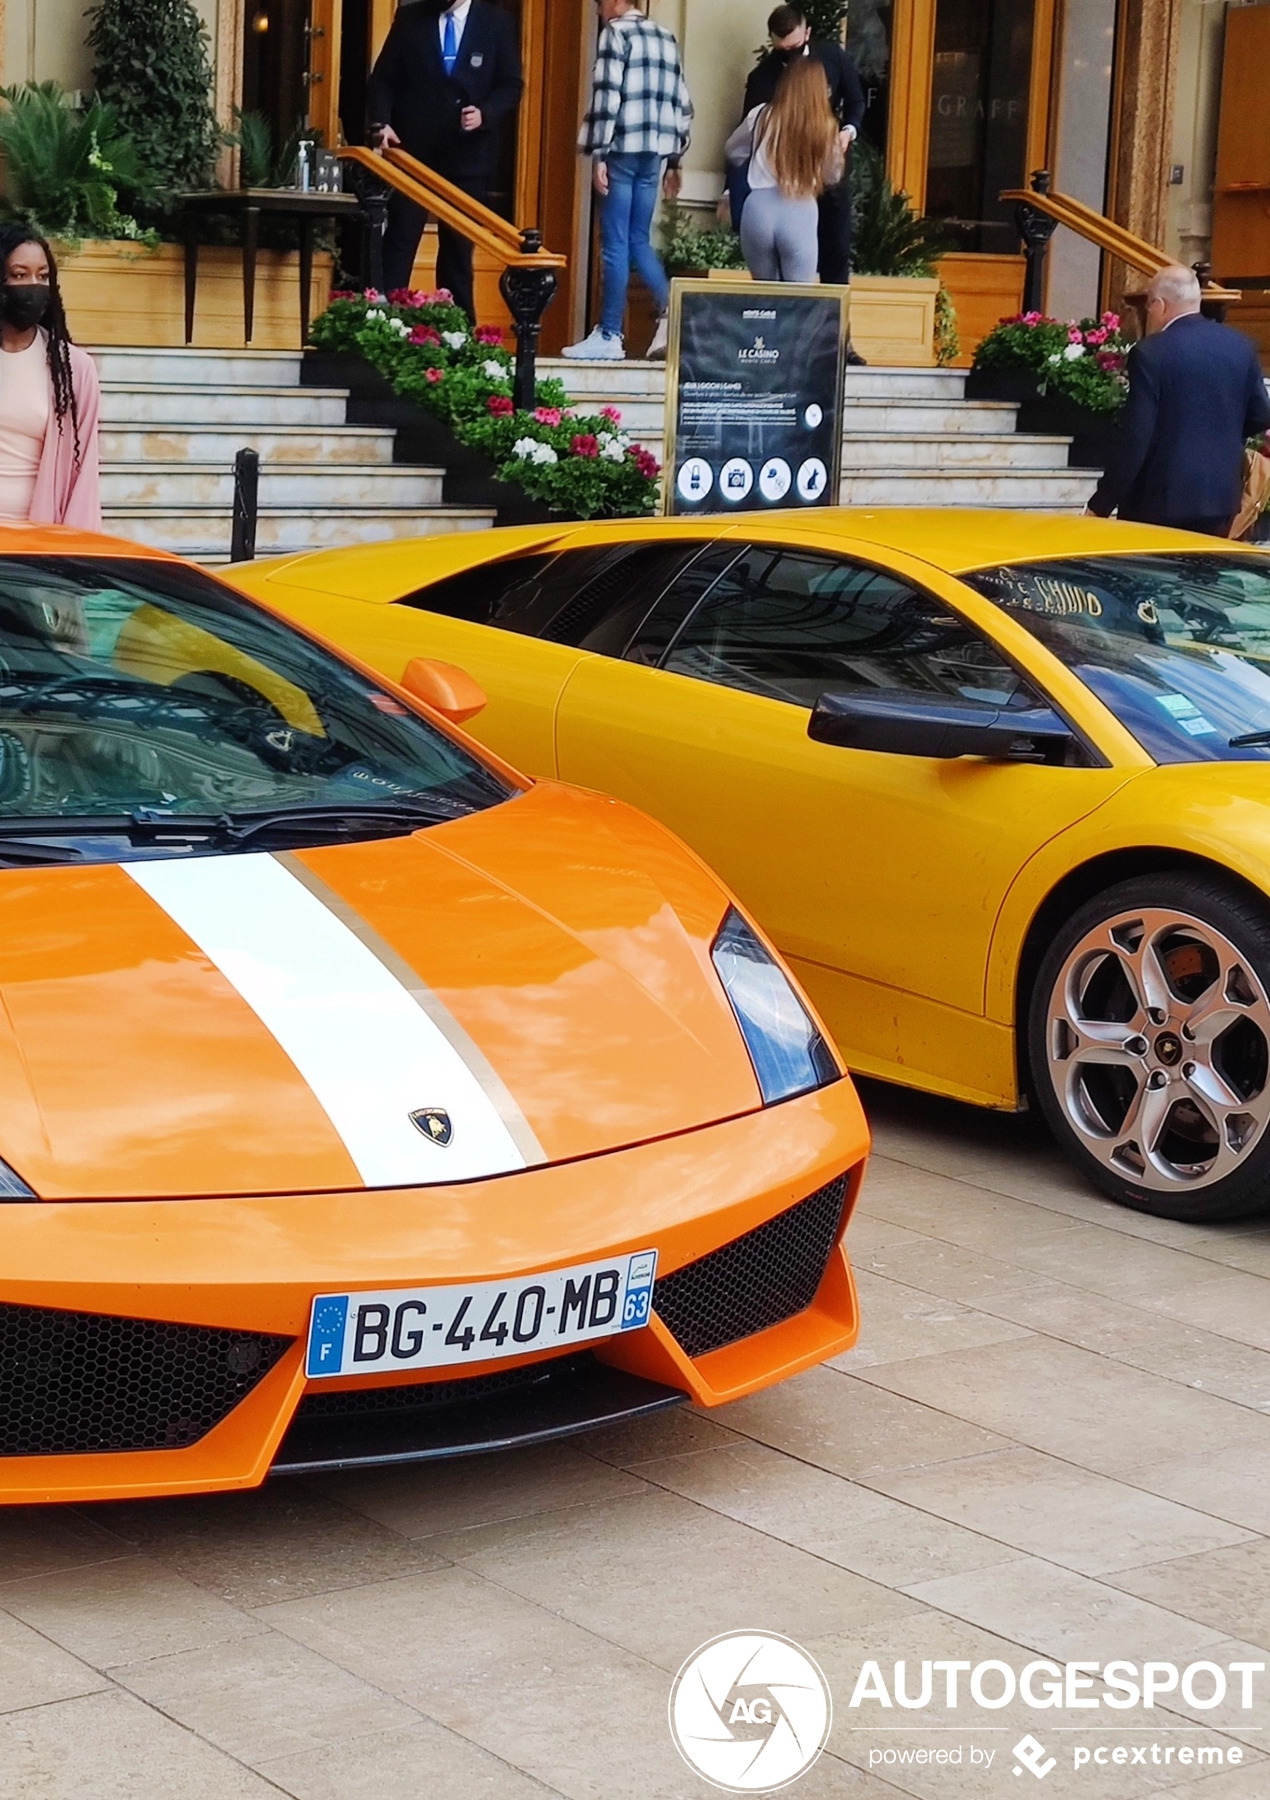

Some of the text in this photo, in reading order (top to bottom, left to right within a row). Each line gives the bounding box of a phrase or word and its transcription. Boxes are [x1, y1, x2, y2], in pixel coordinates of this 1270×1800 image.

[937, 94, 1018, 119] GRAFF
[738, 349, 779, 359] LE CASINO
[353, 1269, 620, 1362] BG-440-MB
[624, 1291, 649, 1321] 63
[320, 1343, 332, 1361] F
